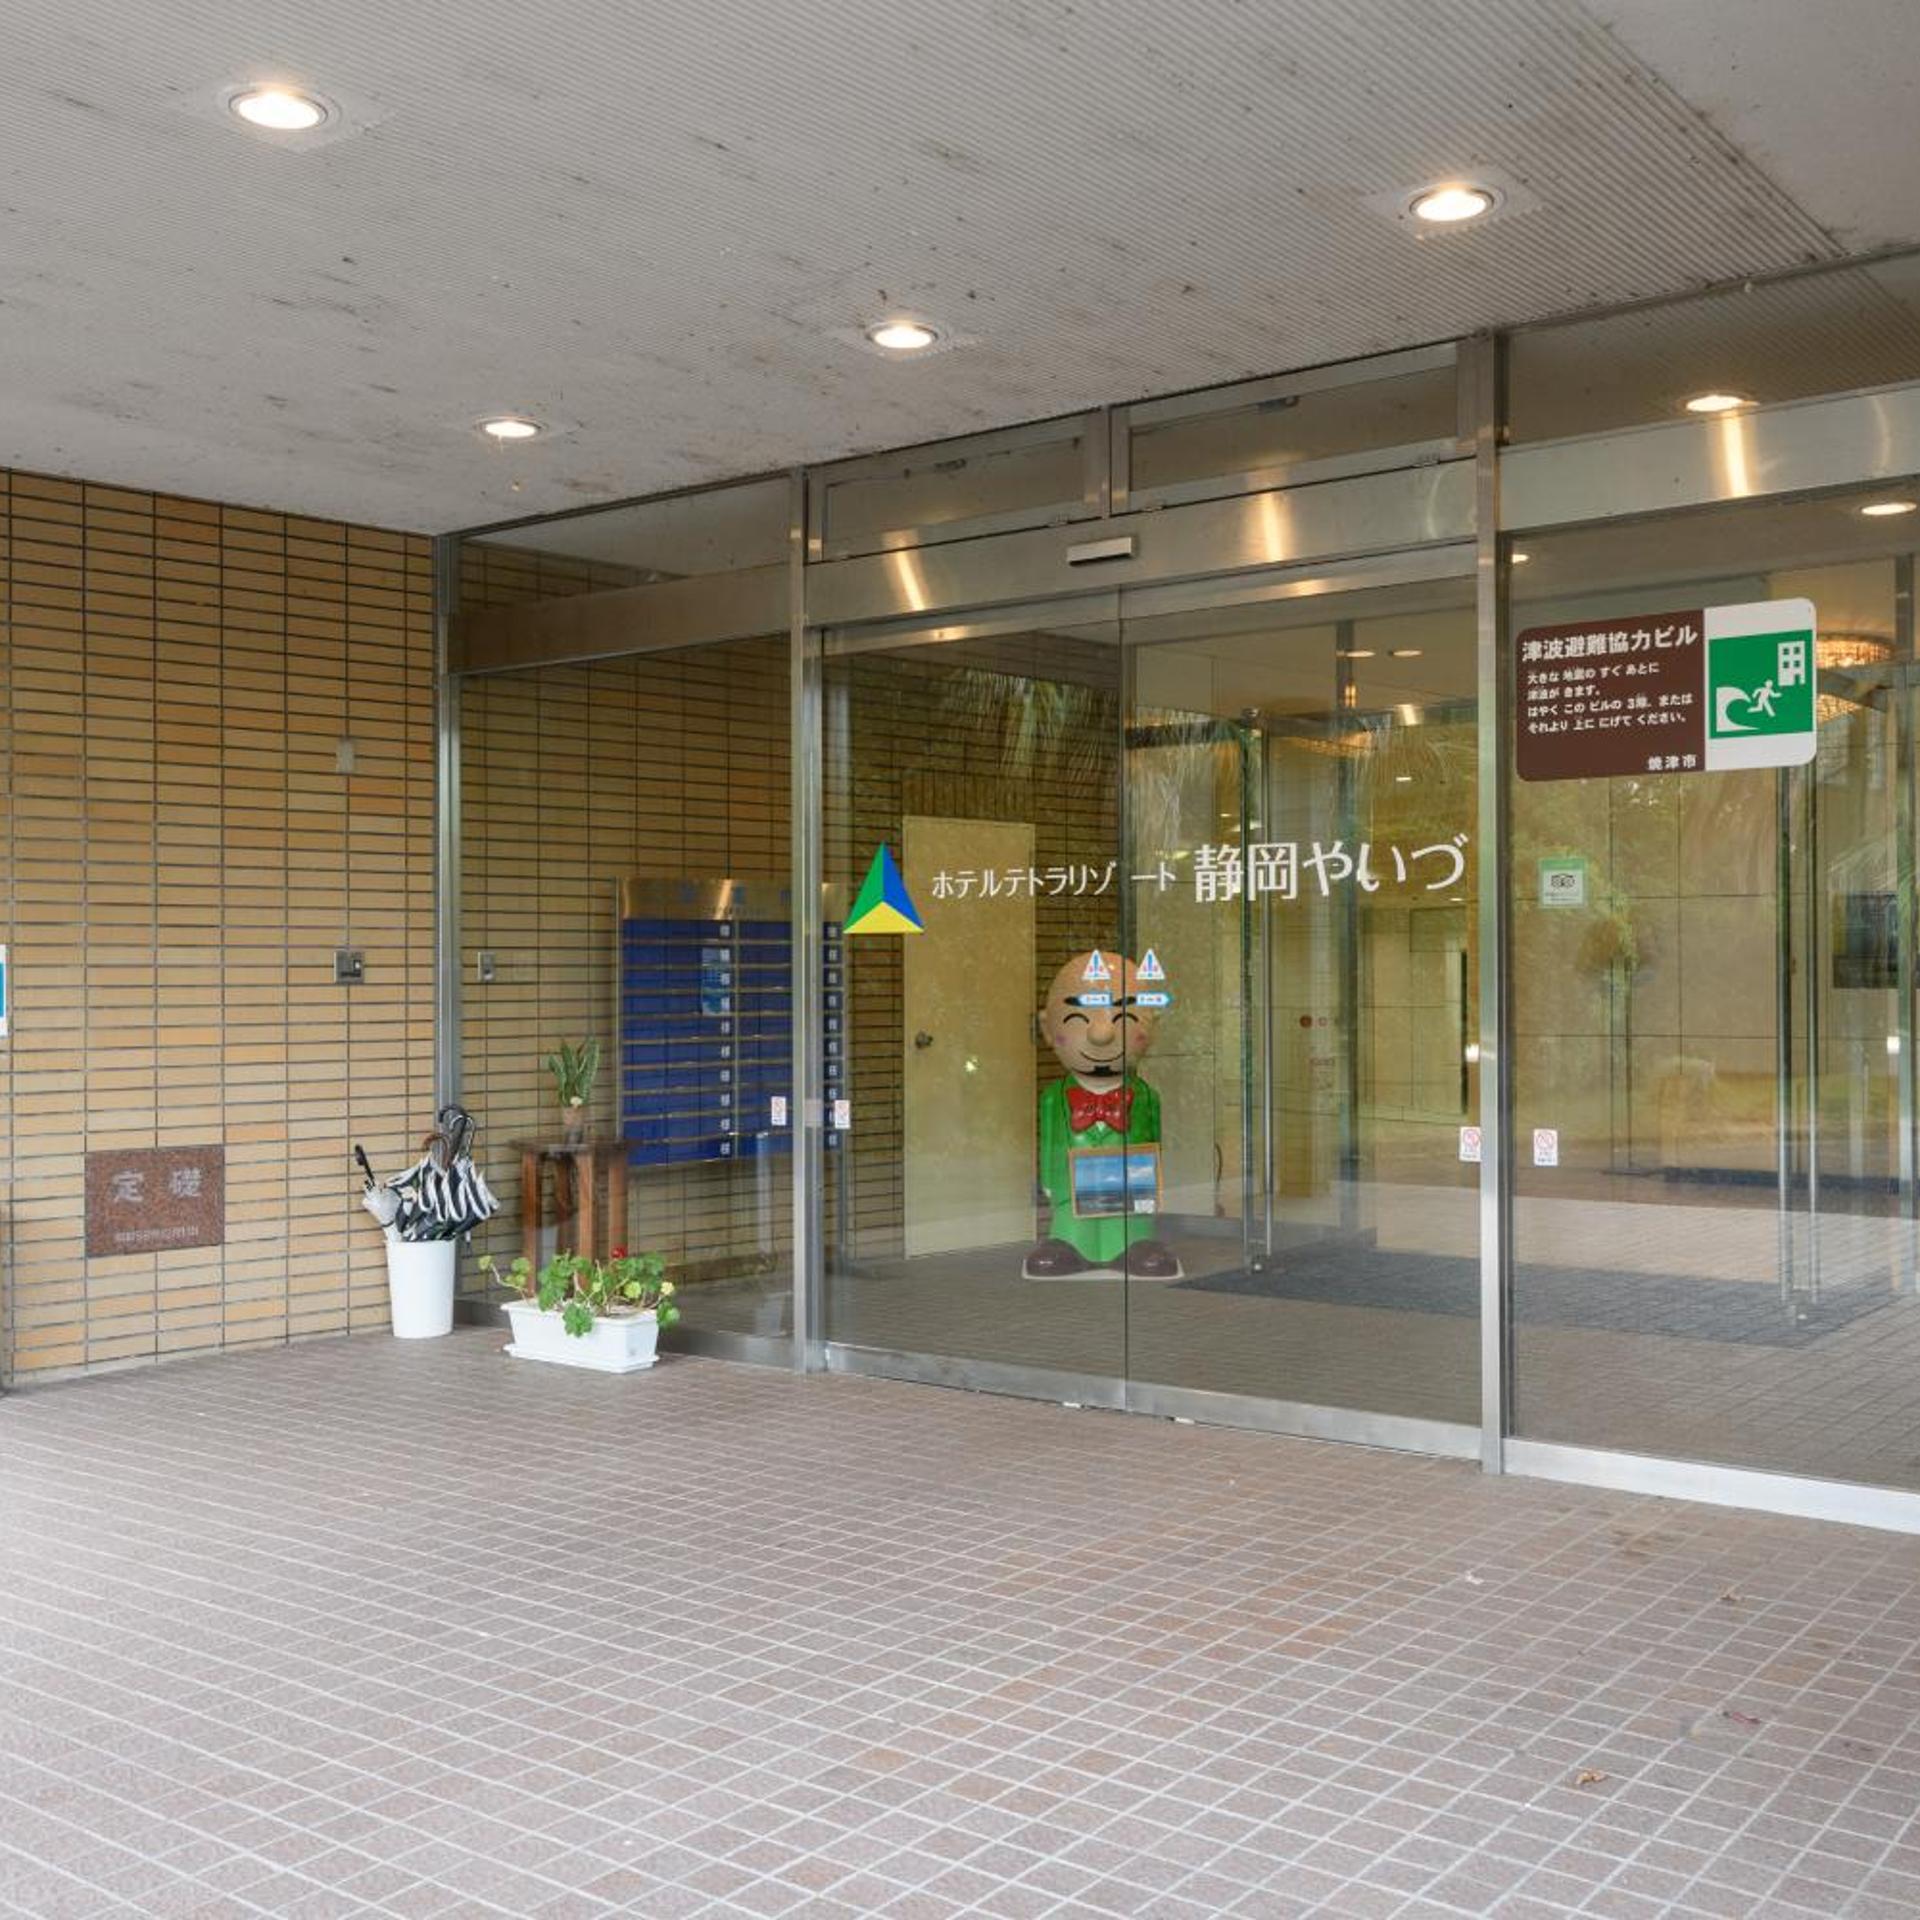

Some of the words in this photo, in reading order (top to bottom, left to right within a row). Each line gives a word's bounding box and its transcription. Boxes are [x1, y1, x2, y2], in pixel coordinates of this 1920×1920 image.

[1522, 625, 1698, 662] 津波避難協力ビル
[1527, 704, 1558, 718] はやく
[1563, 702, 1586, 715] この
[1589, 699, 1623, 712] ビルの
[1573, 717, 1596, 732] 上に
[1599, 715, 1633, 729] にげて
[1637, 711, 1687, 726] ください。
[1647, 753, 1698, 770] 焼津市
[1194, 832, 1469, 903] 静岡やいづ
